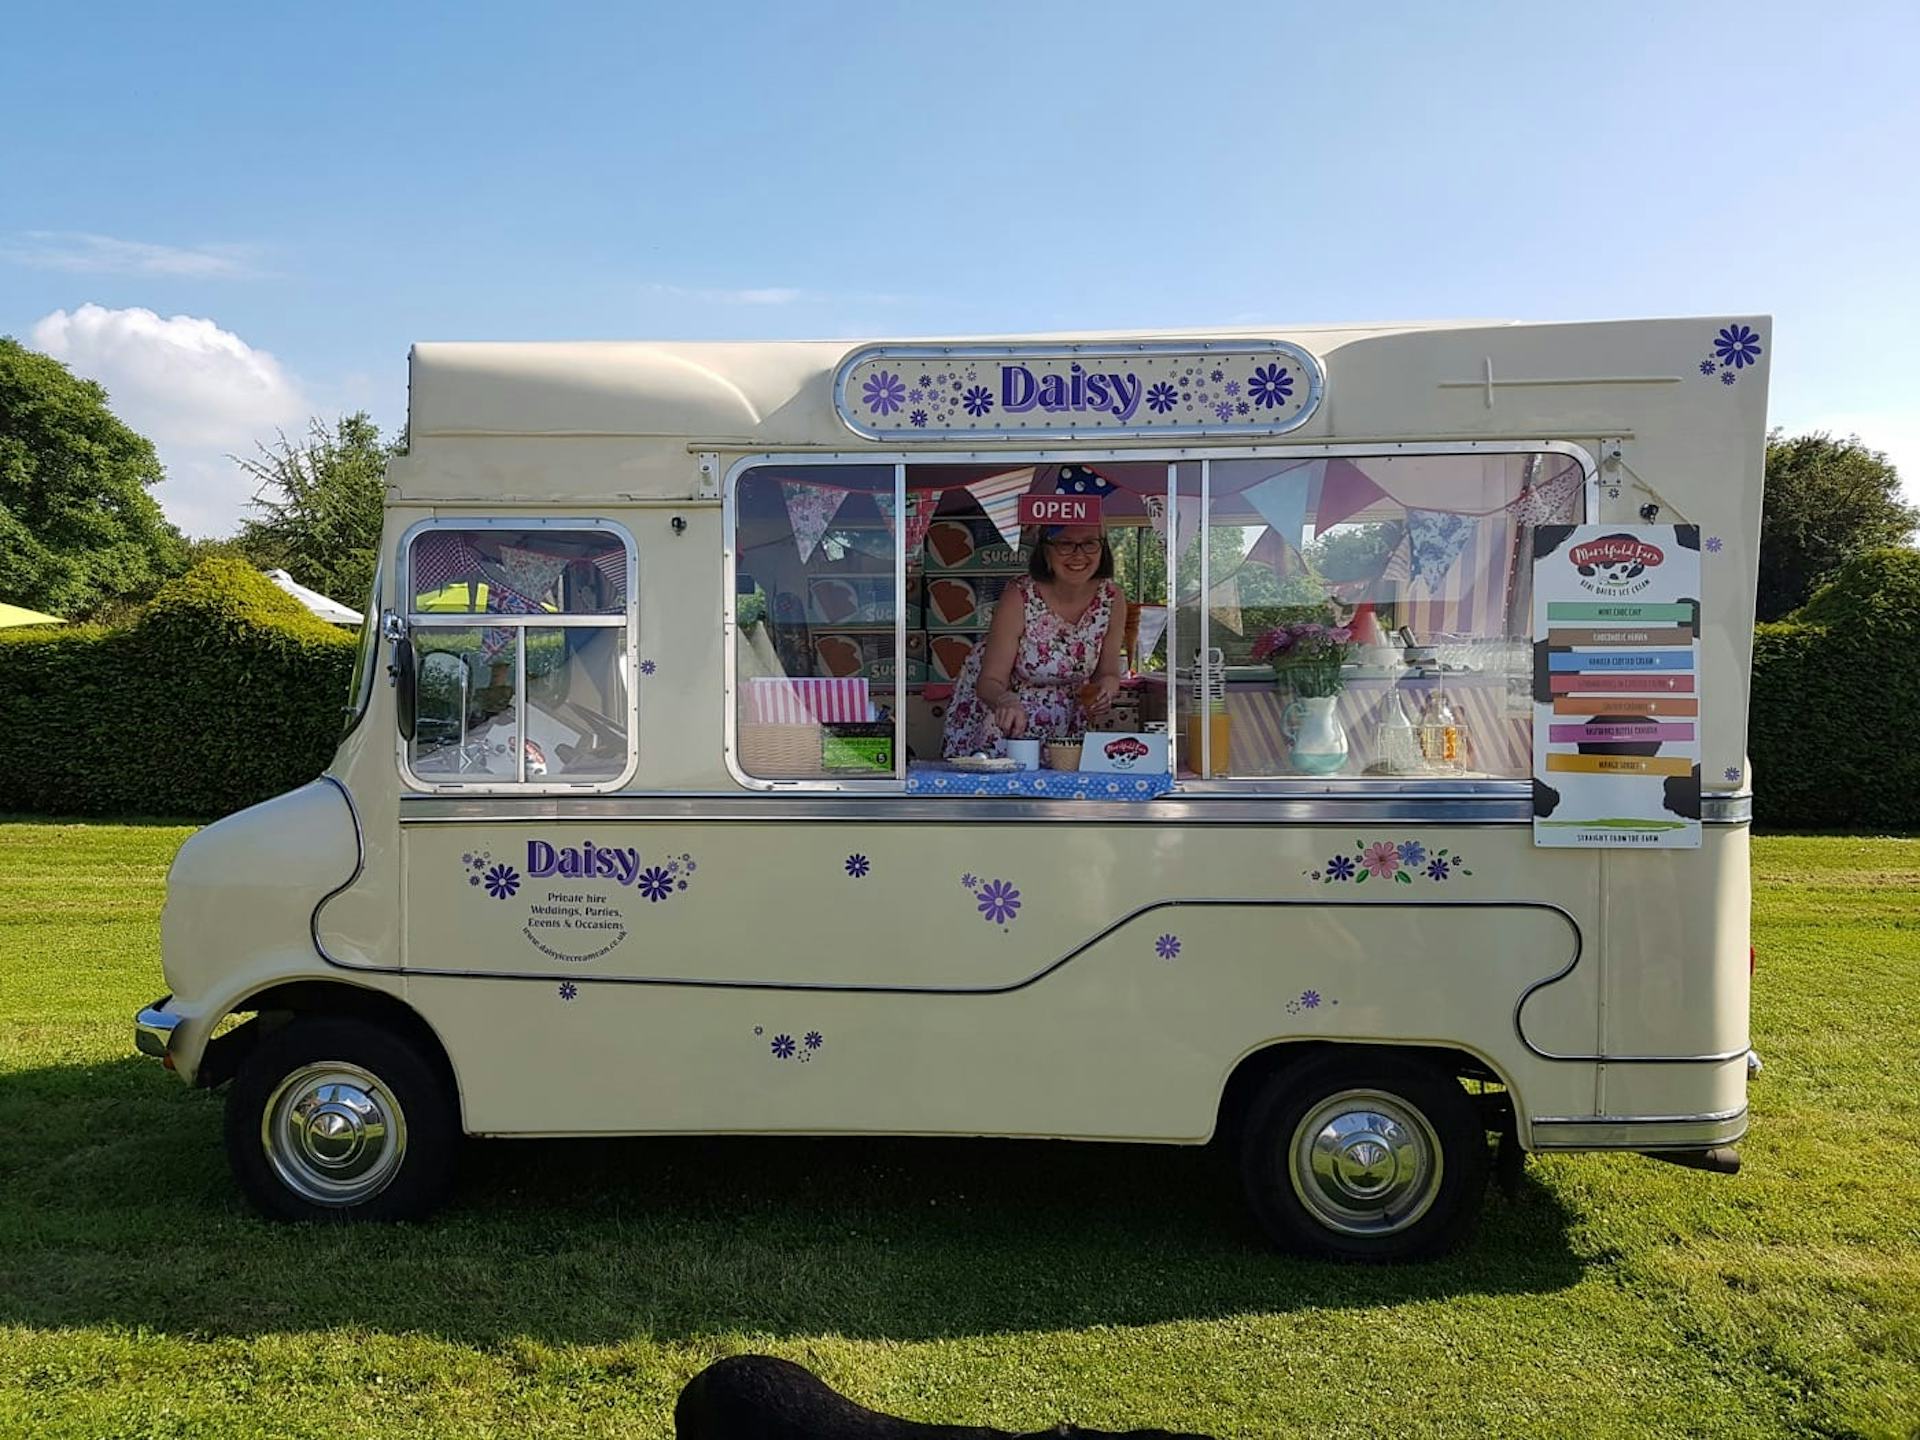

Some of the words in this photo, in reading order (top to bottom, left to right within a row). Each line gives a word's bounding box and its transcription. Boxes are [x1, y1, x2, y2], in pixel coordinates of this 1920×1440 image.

[1001, 363, 1141, 422] Daisy
[1032, 501, 1086, 519] OPEN
[981, 550, 1028, 565] SUGAR
[1619, 588, 1630, 597] ICE
[1632, 579, 1650, 594] CREAM
[866, 607, 912, 622] SUGR
[871, 664, 916, 679] SUGR
[527, 840, 640, 886] Daisy
[548, 892, 583, 902] Private
[587, 894, 607, 903] hire
[531, 905, 582, 917] Weddings,
[585, 907, 622, 917] Parties,
[528, 918, 560, 928] Events
[564, 920, 572, 928] &
[575, 919, 624, 929] Occasions
